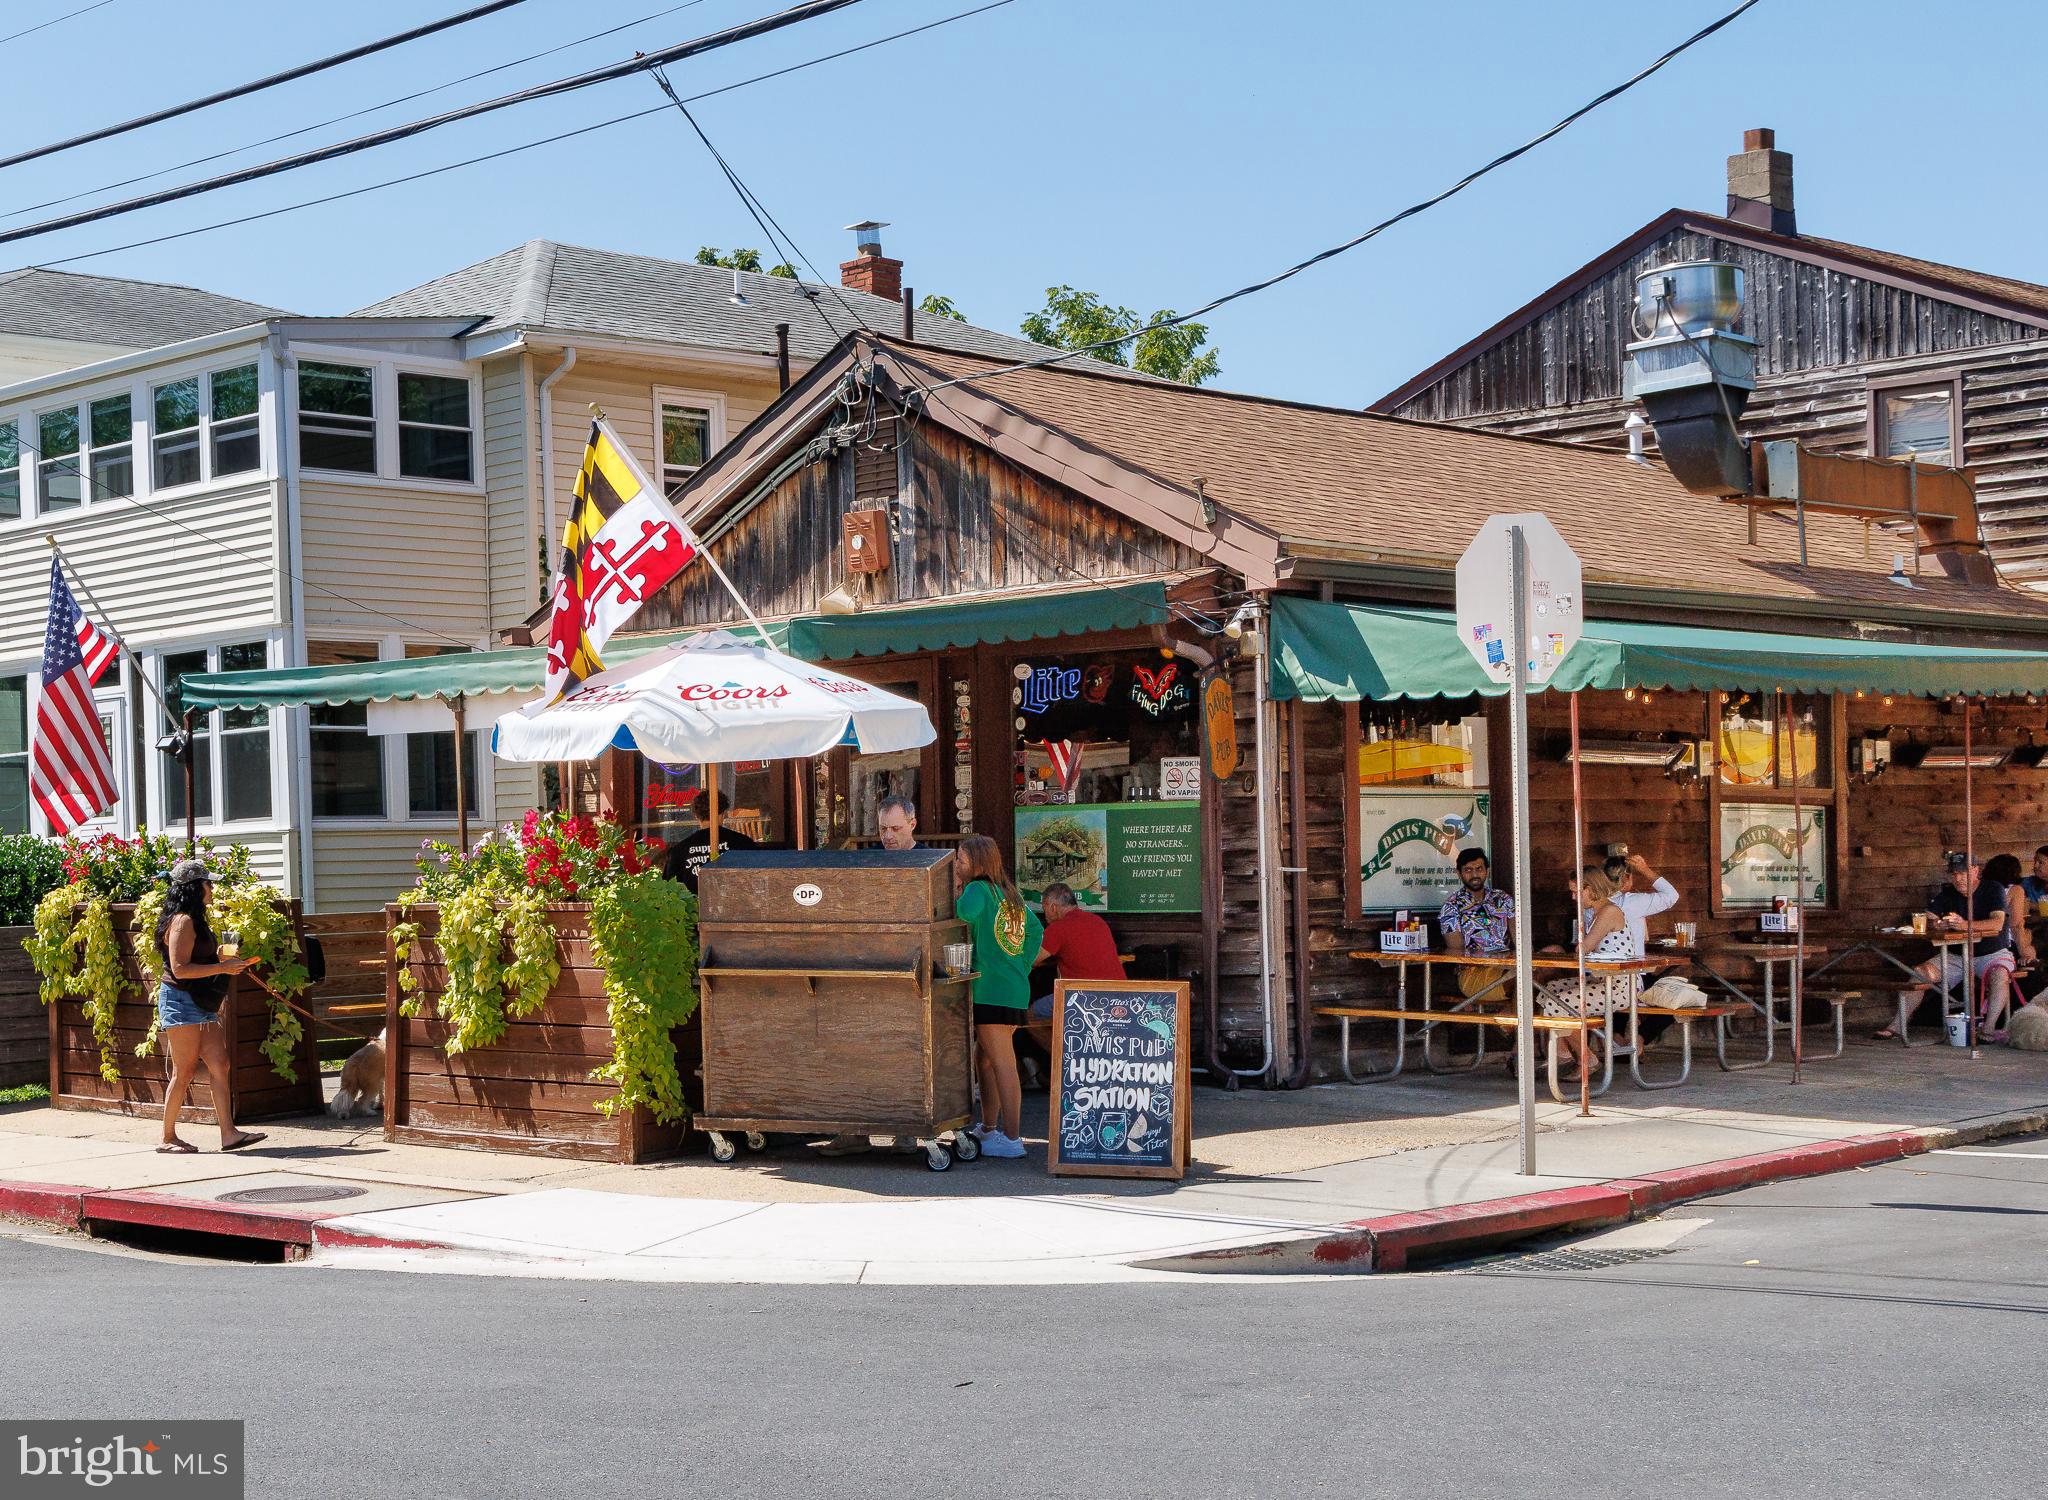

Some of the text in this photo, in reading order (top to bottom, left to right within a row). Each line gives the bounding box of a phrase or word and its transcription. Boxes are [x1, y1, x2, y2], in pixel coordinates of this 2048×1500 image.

[677, 684, 791, 701] Coors
[805, 678, 868, 693] Coors
[1021, 667, 1081, 714] Lite
[694, 698, 782, 712] LIGHT
[1132, 684, 1184, 716] FLYING DOG
[1123, 825, 1192, 834] WHERE THERE ARE
[1381, 823, 1422, 850] DAVIS'
[689, 841, 730, 854] supprt
[1125, 840, 1189, 849] NO STRANGERS...
[685, 854, 709, 869] your
[1122, 855, 1141, 863] ONLY
[1177, 854, 1193, 862] YOU
[1132, 869, 1182, 877] HAVEN'T MET
[800, 890, 815, 899] DP
[1763, 915, 1781, 926] Lite
[1384, 934, 1401, 946] Lite
[1109, 998, 1130, 1006] Tito's
[1068, 1035, 1167, 1057] DAVIS' PUB
[1069, 1057, 1174, 1085] HYDRATION
[1073, 1085, 1151, 1112] STATION
